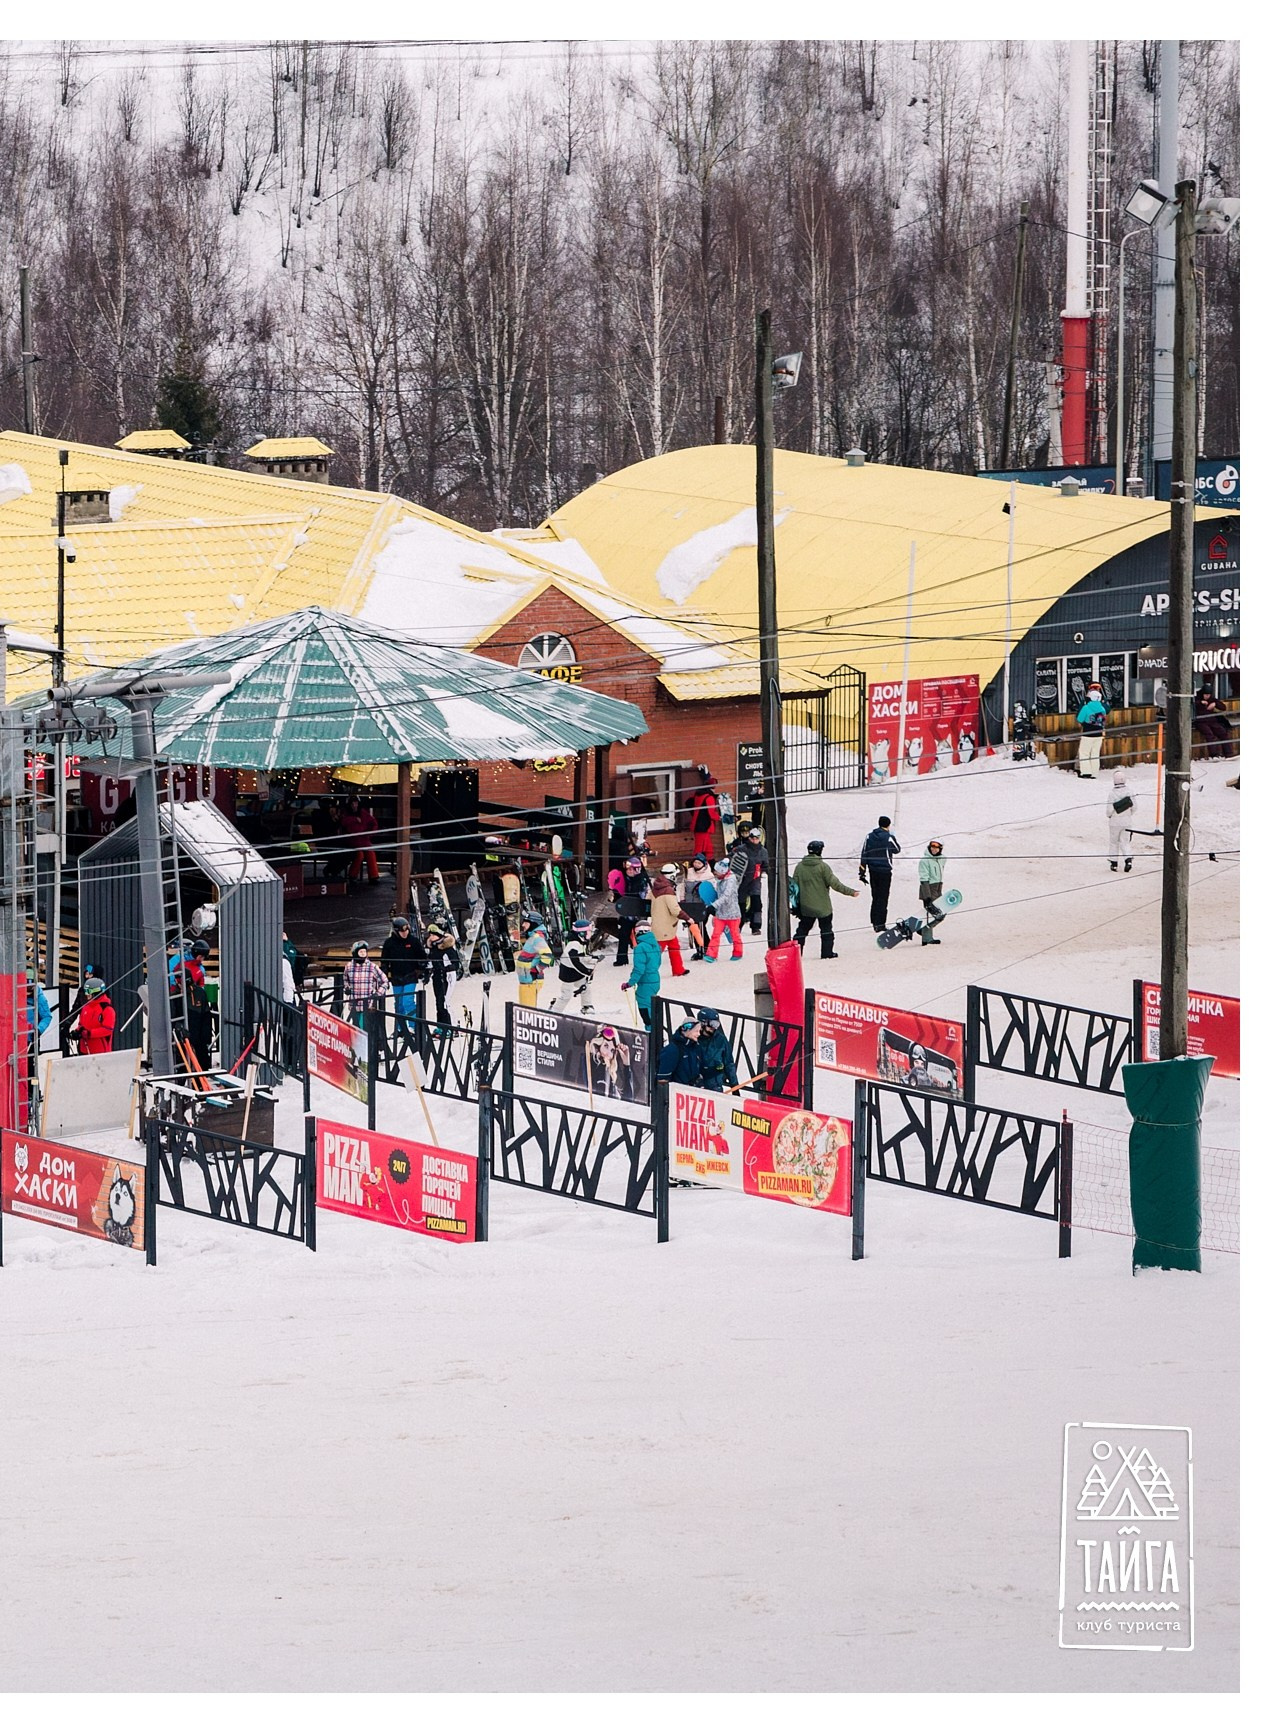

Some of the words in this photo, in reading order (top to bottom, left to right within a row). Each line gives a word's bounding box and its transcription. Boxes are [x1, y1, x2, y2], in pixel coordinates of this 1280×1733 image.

[1200, 561, 1238, 571] GUBAHA
[872, 685, 904, 702] ДОМ
[282, 873, 288, 883] 1
[321, 885, 327, 894] 3
[516, 1009, 557, 1031] LIMITED
[818, 997, 889, 1026] GUBAHABUS
[516, 1026, 559, 1048] EDITION
[536, 1057, 555, 1068] СТИЛЯ
[537, 1049, 563, 1062] ВЕРШИНА
[676, 1092, 715, 1125] PIZZA
[676, 1120, 709, 1153] MAN
[323, 1132, 371, 1175] PIZZA
[676, 1153, 694, 1165] ПЕРМЬ
[39, 1152, 76, 1180] ДОМ
[392, 1159, 407, 1173] 24/7
[422, 1154, 469, 1183] ДОСТАВКА
[706, 1160, 729, 1172] ИЖЕВСК
[14, 1172, 78, 1209] ХАСКИ
[323, 1165, 363, 1207] MAN
[422, 1174, 461, 1201] ГОРЯЧЕЙ
[760, 1175, 812, 1194] PIZZAMAN.RU
[422, 1194, 456, 1220] ПИЦЦЫ
[426, 1216, 467, 1234] PIZZAMAN.RU
